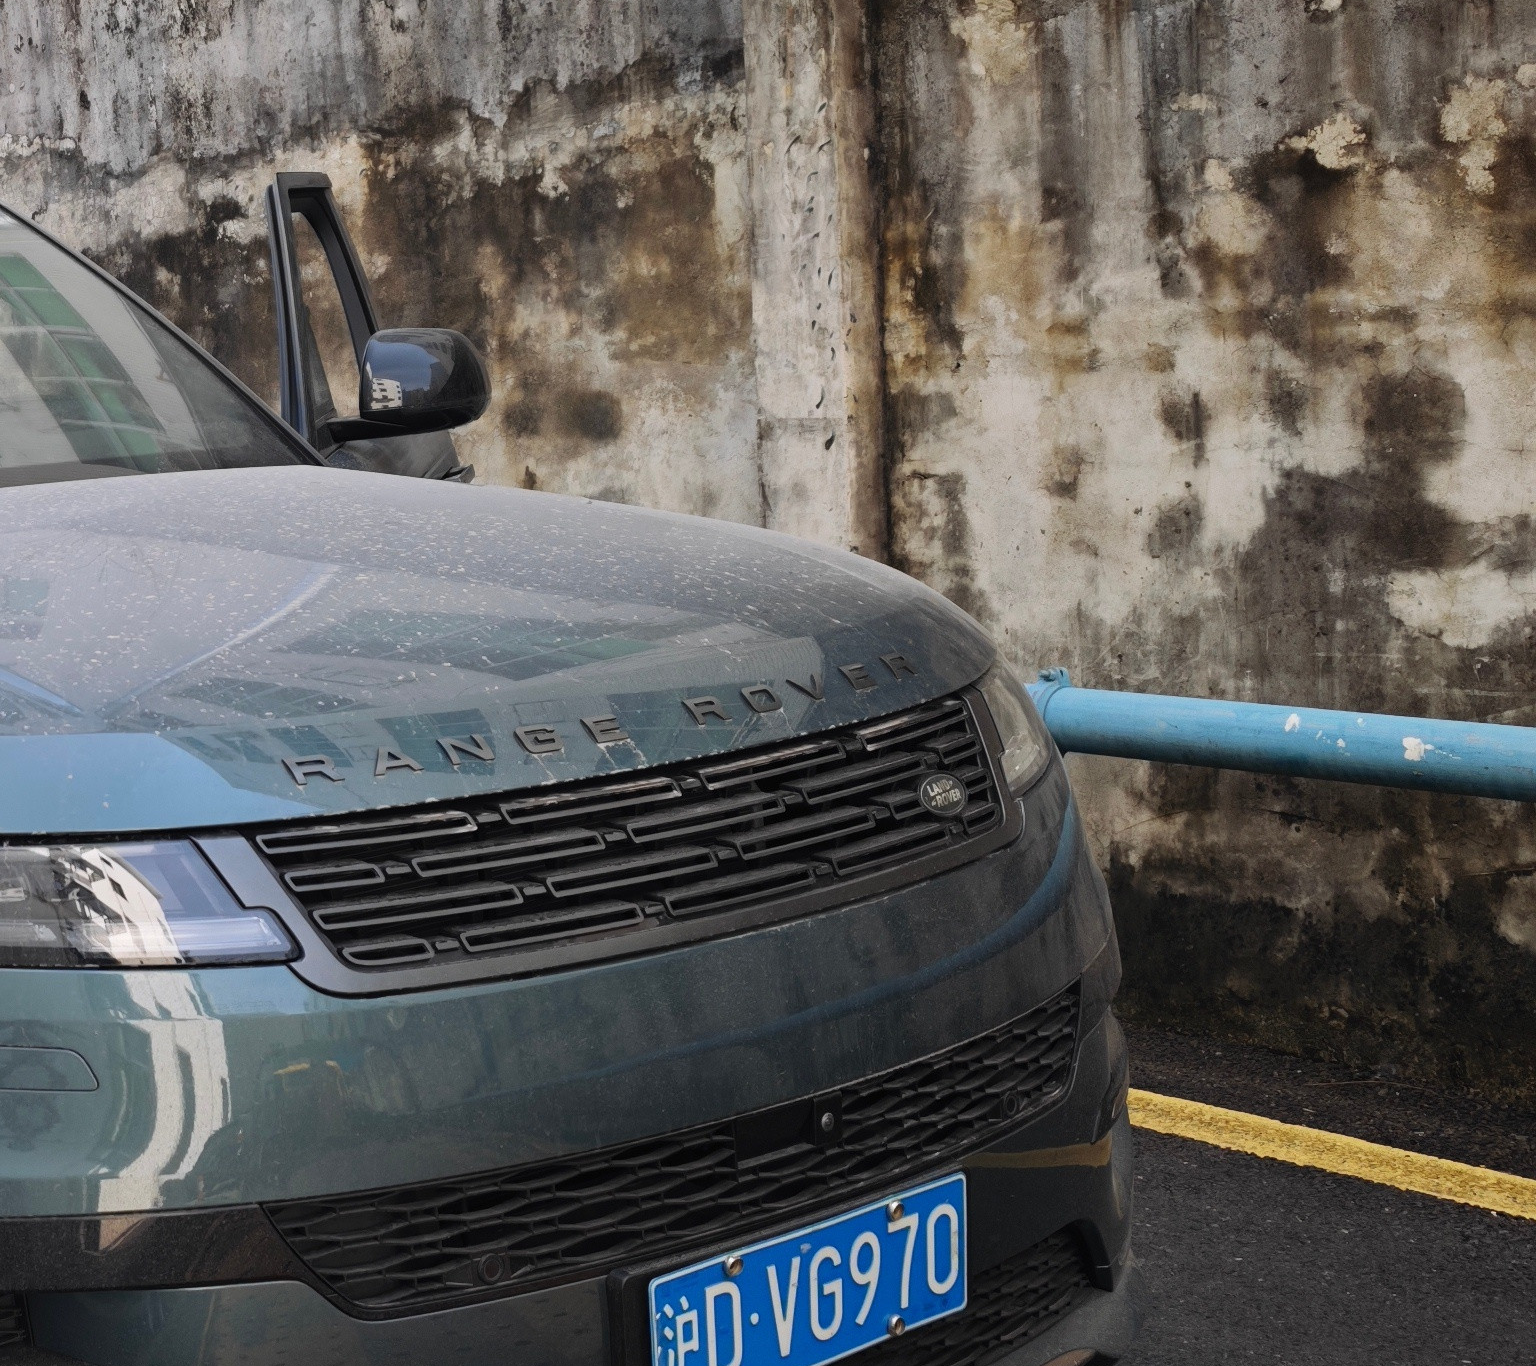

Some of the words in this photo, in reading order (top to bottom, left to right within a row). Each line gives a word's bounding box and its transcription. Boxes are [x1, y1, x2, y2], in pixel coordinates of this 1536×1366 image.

[281, 716, 629, 786] RANGE
[682, 652, 919, 726] ROVER
[927, 780, 951, 797] LAND
[935, 788, 962, 807] ROVER
